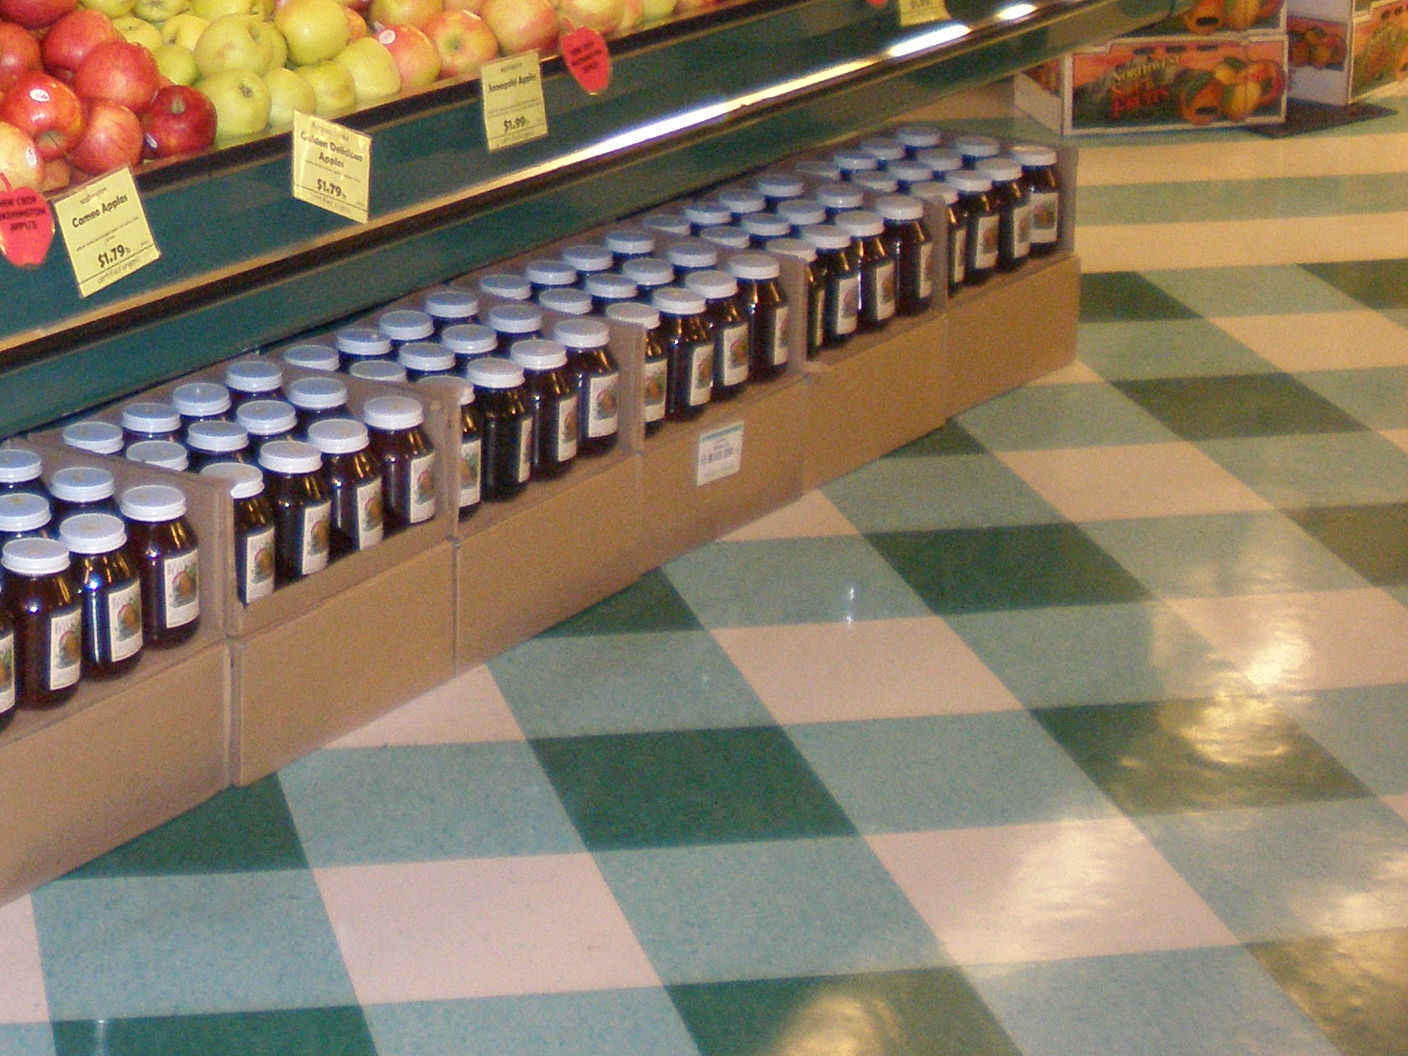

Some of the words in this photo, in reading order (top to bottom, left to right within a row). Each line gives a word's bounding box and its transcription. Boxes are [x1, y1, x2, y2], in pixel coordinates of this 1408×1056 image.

[503, 116, 526, 133] $1.99
[316, 178, 342, 198] $1.79
[71, 209, 101, 229] Cameo
[100, 193, 129, 214] Apples
[97, 244, 126, 269] $1.79
